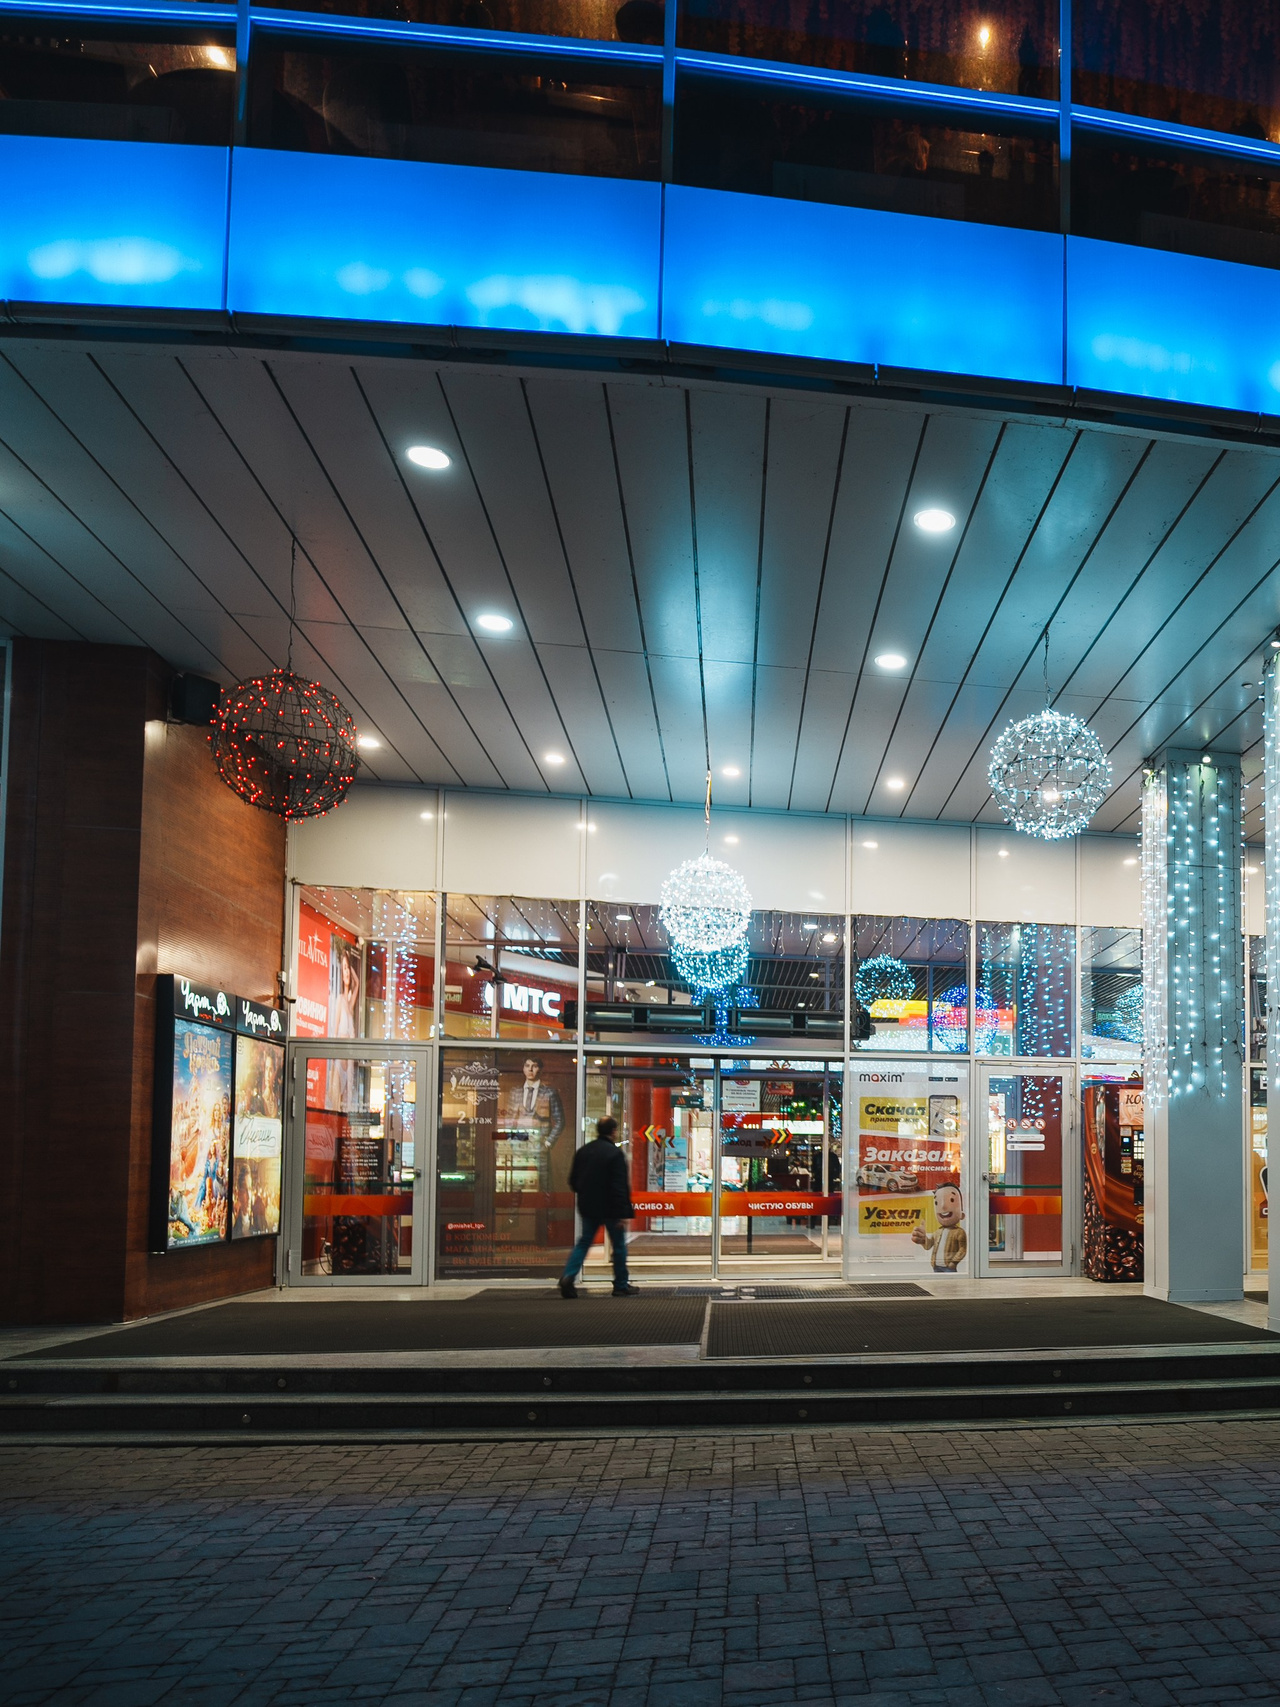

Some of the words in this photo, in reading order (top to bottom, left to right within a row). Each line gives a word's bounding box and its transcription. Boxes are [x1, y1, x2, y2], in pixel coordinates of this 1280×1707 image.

[502, 983, 561, 1017] МТС
[1126, 1094, 1144, 1105] КО
[864, 1103, 926, 1116] Скачал
[457, 1110, 466, 1124] 2
[468, 1117, 492, 1125] этаж
[863, 1146, 953, 1162] Заказал
[785, 1202, 814, 1210] ОБУВЬ!
[864, 1206, 921, 1220] Уехал
[455, 1232, 498, 1242] КОСТЮМЕ
[500, 1232, 511, 1241] ОТ
[446, 1244, 493, 1253] МАГАЗИНА
[453, 1257, 466, 1266] ВЫ
[469, 1257, 502, 1266] БУДЕТЕ
